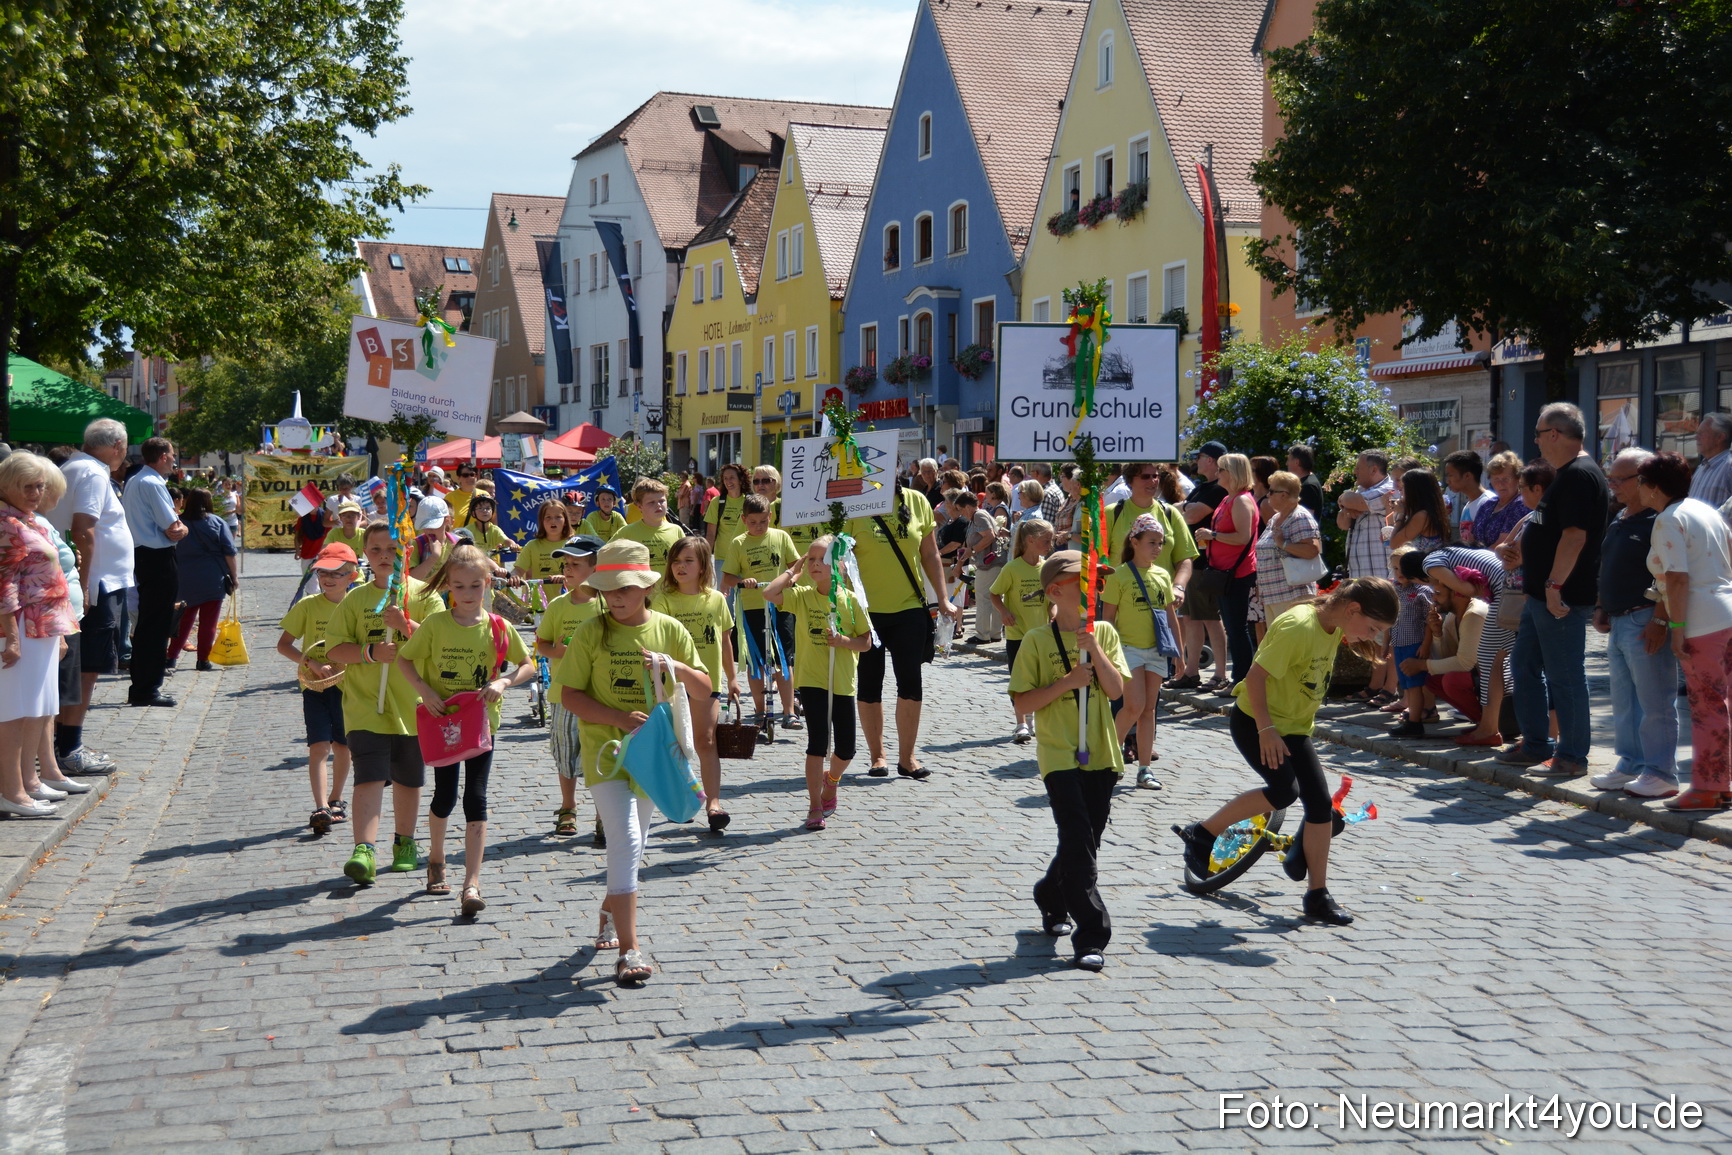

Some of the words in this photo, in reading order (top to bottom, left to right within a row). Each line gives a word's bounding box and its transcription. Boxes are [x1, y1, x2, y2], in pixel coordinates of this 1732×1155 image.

[703, 322, 723, 341] HOTEL
[391, 388, 427, 404] Bildung
[428, 395, 456, 407] durch
[785, 394, 791, 413] P
[390, 399, 429, 415] Sprache
[431, 406, 449, 418] und
[451, 411, 482, 424] Schrift
[701, 412, 730, 426] Restaurant
[291, 464, 324, 476] MIT
[790, 446, 805, 489] SINUS
[796, 511, 809, 519] Wir
[810, 508, 826, 518] sind
[610, 658, 641, 666] Holzheim
